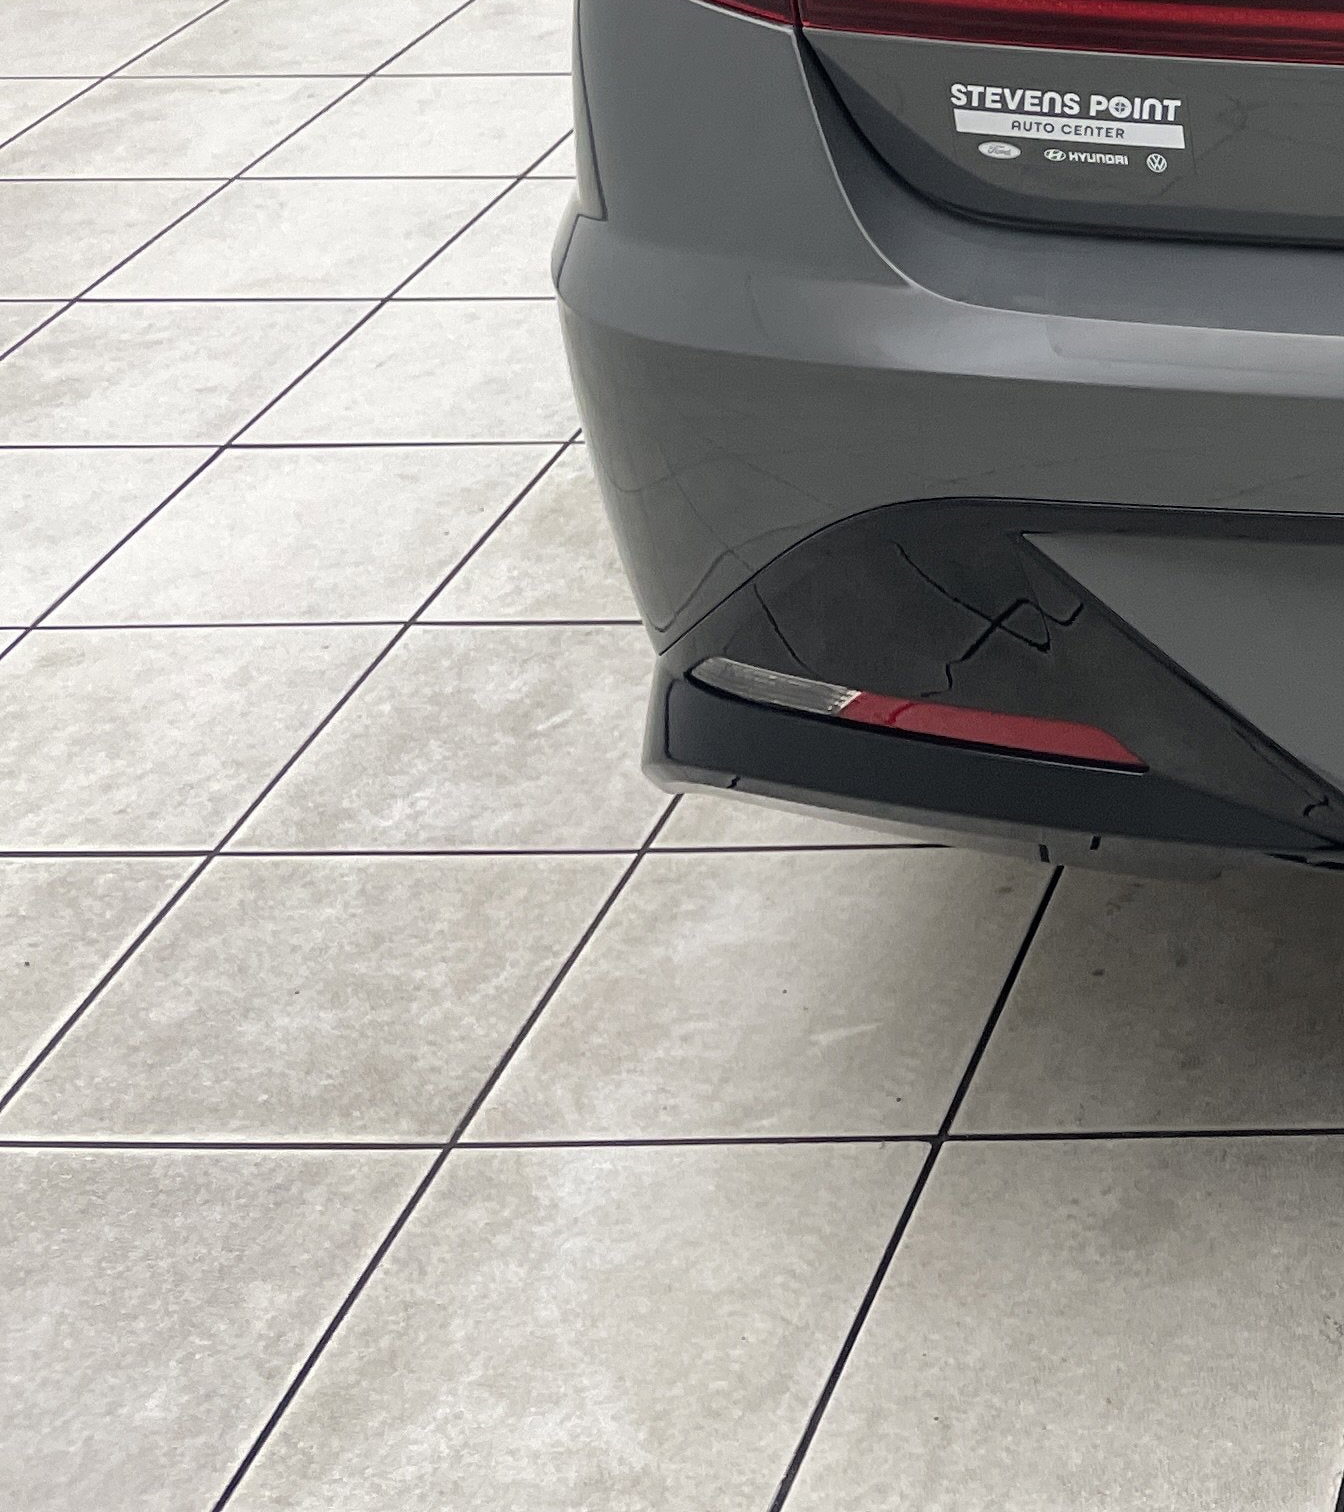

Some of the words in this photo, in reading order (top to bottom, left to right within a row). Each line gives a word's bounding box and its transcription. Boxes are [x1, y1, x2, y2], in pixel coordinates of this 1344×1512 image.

[950, 83, 1081, 116] STEVENS
[1089, 94, 1182, 122] POINT
[1011, 119, 1055, 134] AUTO
[1060, 123, 1126, 139] CENTER
[1068, 151, 1129, 166] HYUNDAI
